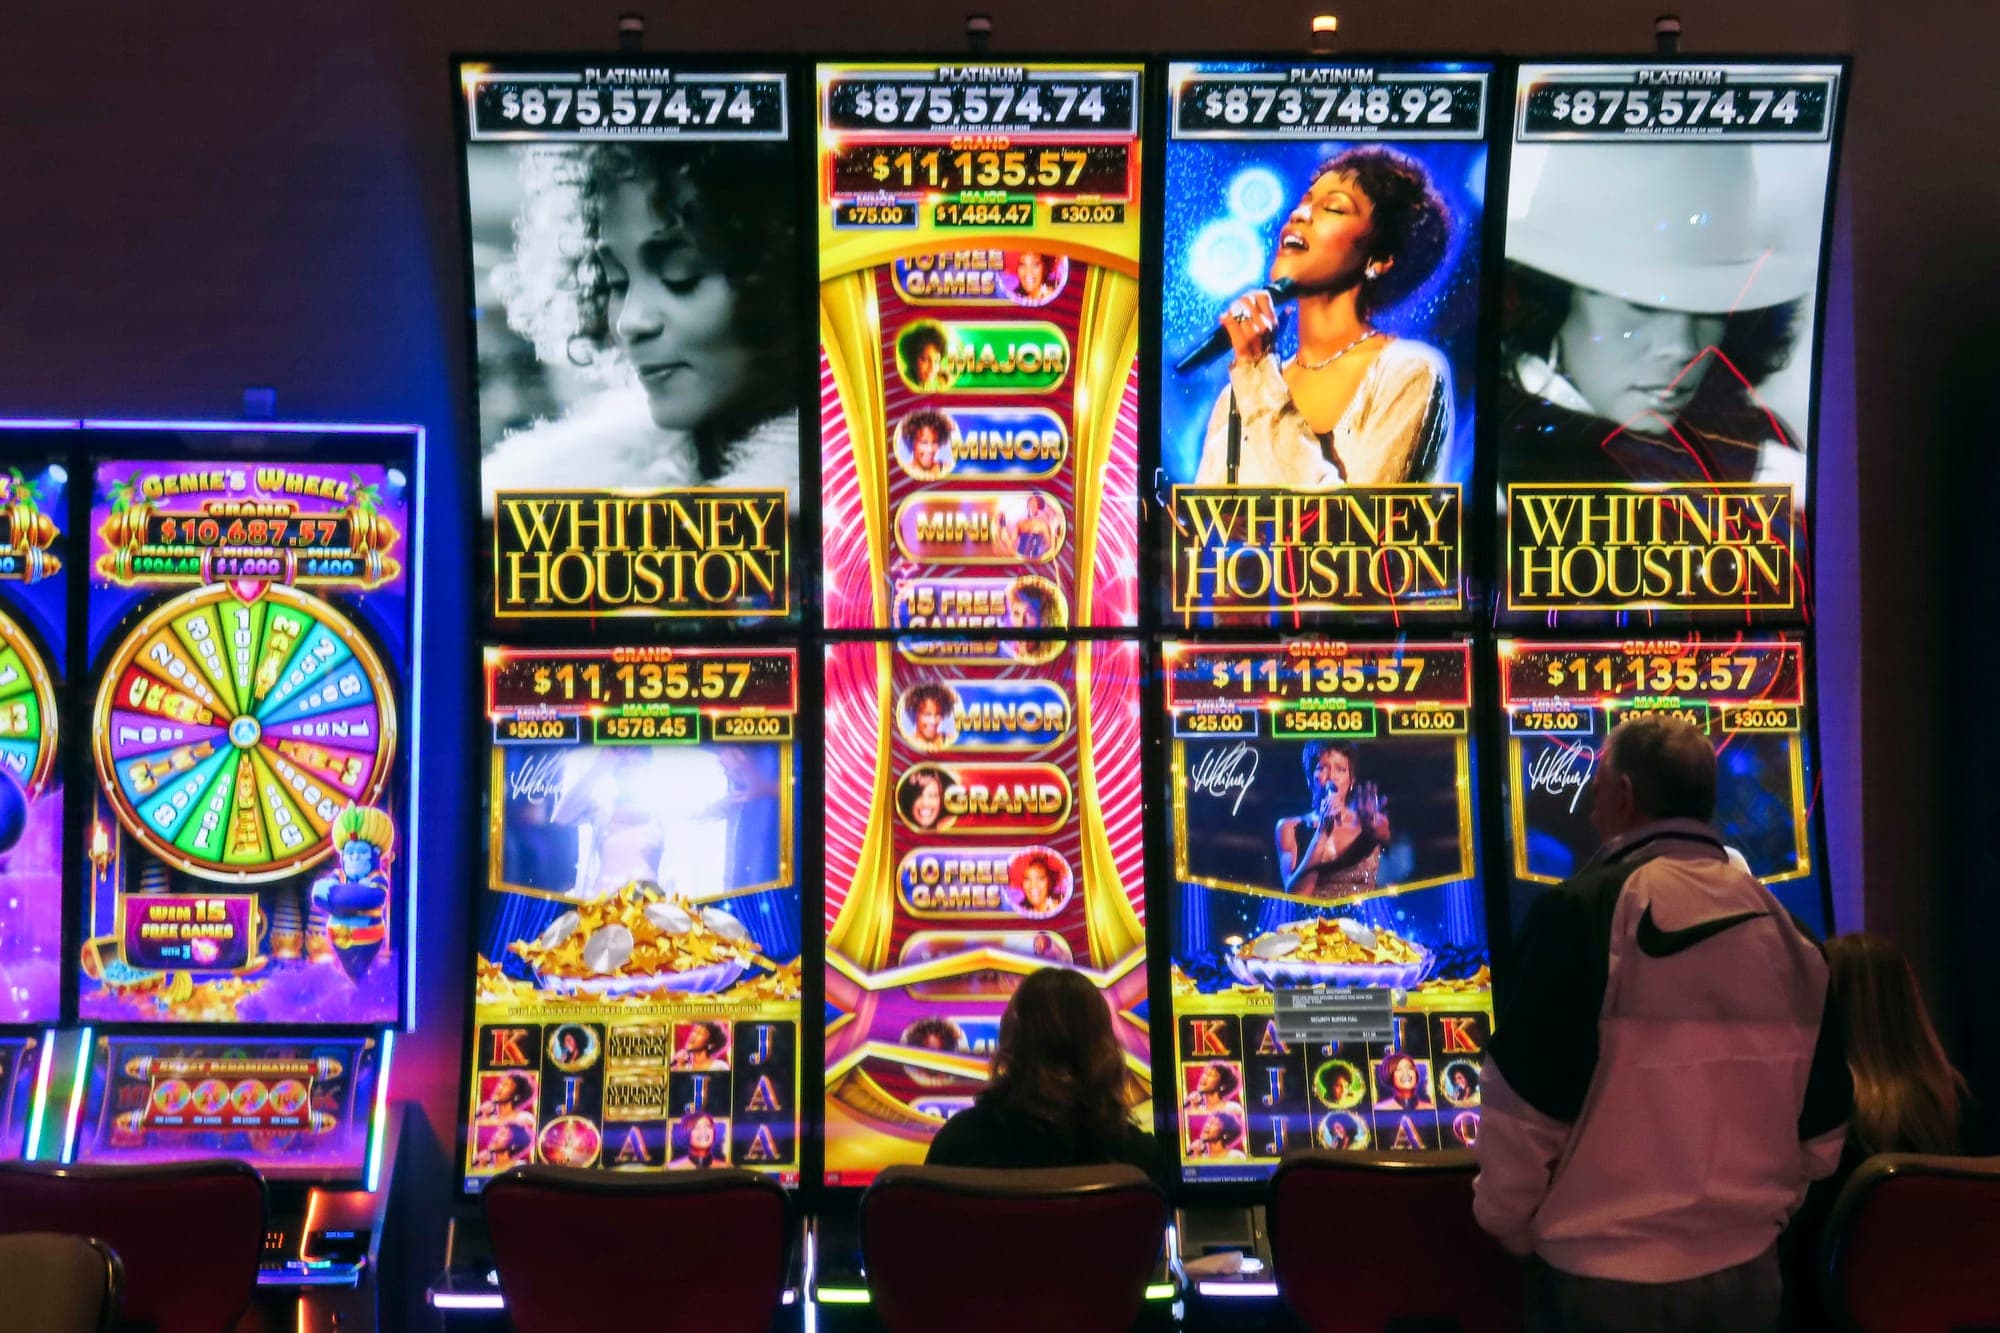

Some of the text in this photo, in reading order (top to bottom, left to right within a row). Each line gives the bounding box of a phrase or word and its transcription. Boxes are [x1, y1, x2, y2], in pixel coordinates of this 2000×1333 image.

[585, 68, 670, 84] PLATINUM
[940, 67, 1023, 82] PLATINUM
[1290, 68, 1374, 83] PLATINUM
[1637, 71, 1721, 85] PLATINUM
[502, 89, 755, 127] $875,574.74
[855, 87, 1105, 124] $875,574.74
[1205, 88, 1453, 125] $873,748.92
[1552, 90, 1798, 128] $875,574.74
[950, 136, 1010, 151] GRAND
[872, 152, 1088, 189] $11,135.57
[849, 207, 903, 224] $75.00
[936, 205, 1032, 224] $1,484.47
[1061, 206, 1115, 222] $30.00
[906, 270, 995, 295] GAMES
[947, 342, 1064, 373] MAJOR
[951, 430, 1061, 461] MINOR
[161, 518, 337, 546] $10,687.57
[502, 499, 781, 552] WHITNEY
[916, 512, 989, 543] MINI
[1181, 494, 1455, 547] WHITNEY
[1516, 493, 1788, 547] WHITNEY
[506, 550, 781, 604] HOUSTON
[1183, 545, 1453, 598] HOUSTON
[1519, 544, 1786, 598] HOUSTON
[907, 587, 1006, 616] 15 FREE
[612, 646, 673, 662] GRAND
[1289, 642, 1348, 657] GRAND
[1622, 641, 1681, 655] GRAND
[534, 663, 751, 702] $11,135.57
[1212, 658, 1425, 695] $11,135.57
[1548, 657, 1758, 694] $11,135.57
[509, 721, 564, 738] $50.00
[607, 718, 686, 737] $578.45
[725, 718, 780, 735] $20.00
[954, 702, 1064, 732] MINOR
[1189, 715, 1243, 732] $25.00
[1285, 711, 1363, 731] $548.08
[1402, 712, 1455, 728] $10.00
[1525, 713, 1578, 731] $75.00
[1735, 711, 1787, 727] $30.00
[944, 785, 1062, 814] GRAND
[907, 858, 1009, 885] 10 FREE
[149, 900, 226, 921] WIN 15
[912, 885, 1001, 908] GAMES
[489, 1028, 529, 1067] K
[749, 1024, 777, 1065] J
[1190, 1019, 1231, 1056] K
[1439, 1018, 1481, 1054] K
[555, 1076, 583, 1115] J
[684, 1075, 712, 1113] J
[745, 1074, 782, 1112] A
[1262, 1066, 1287, 1105] J
[614, 1125, 651, 1162] A
[744, 1124, 782, 1161] A
[1266, 1115, 1289, 1153] J
[1390, 1115, 1426, 1149] A
